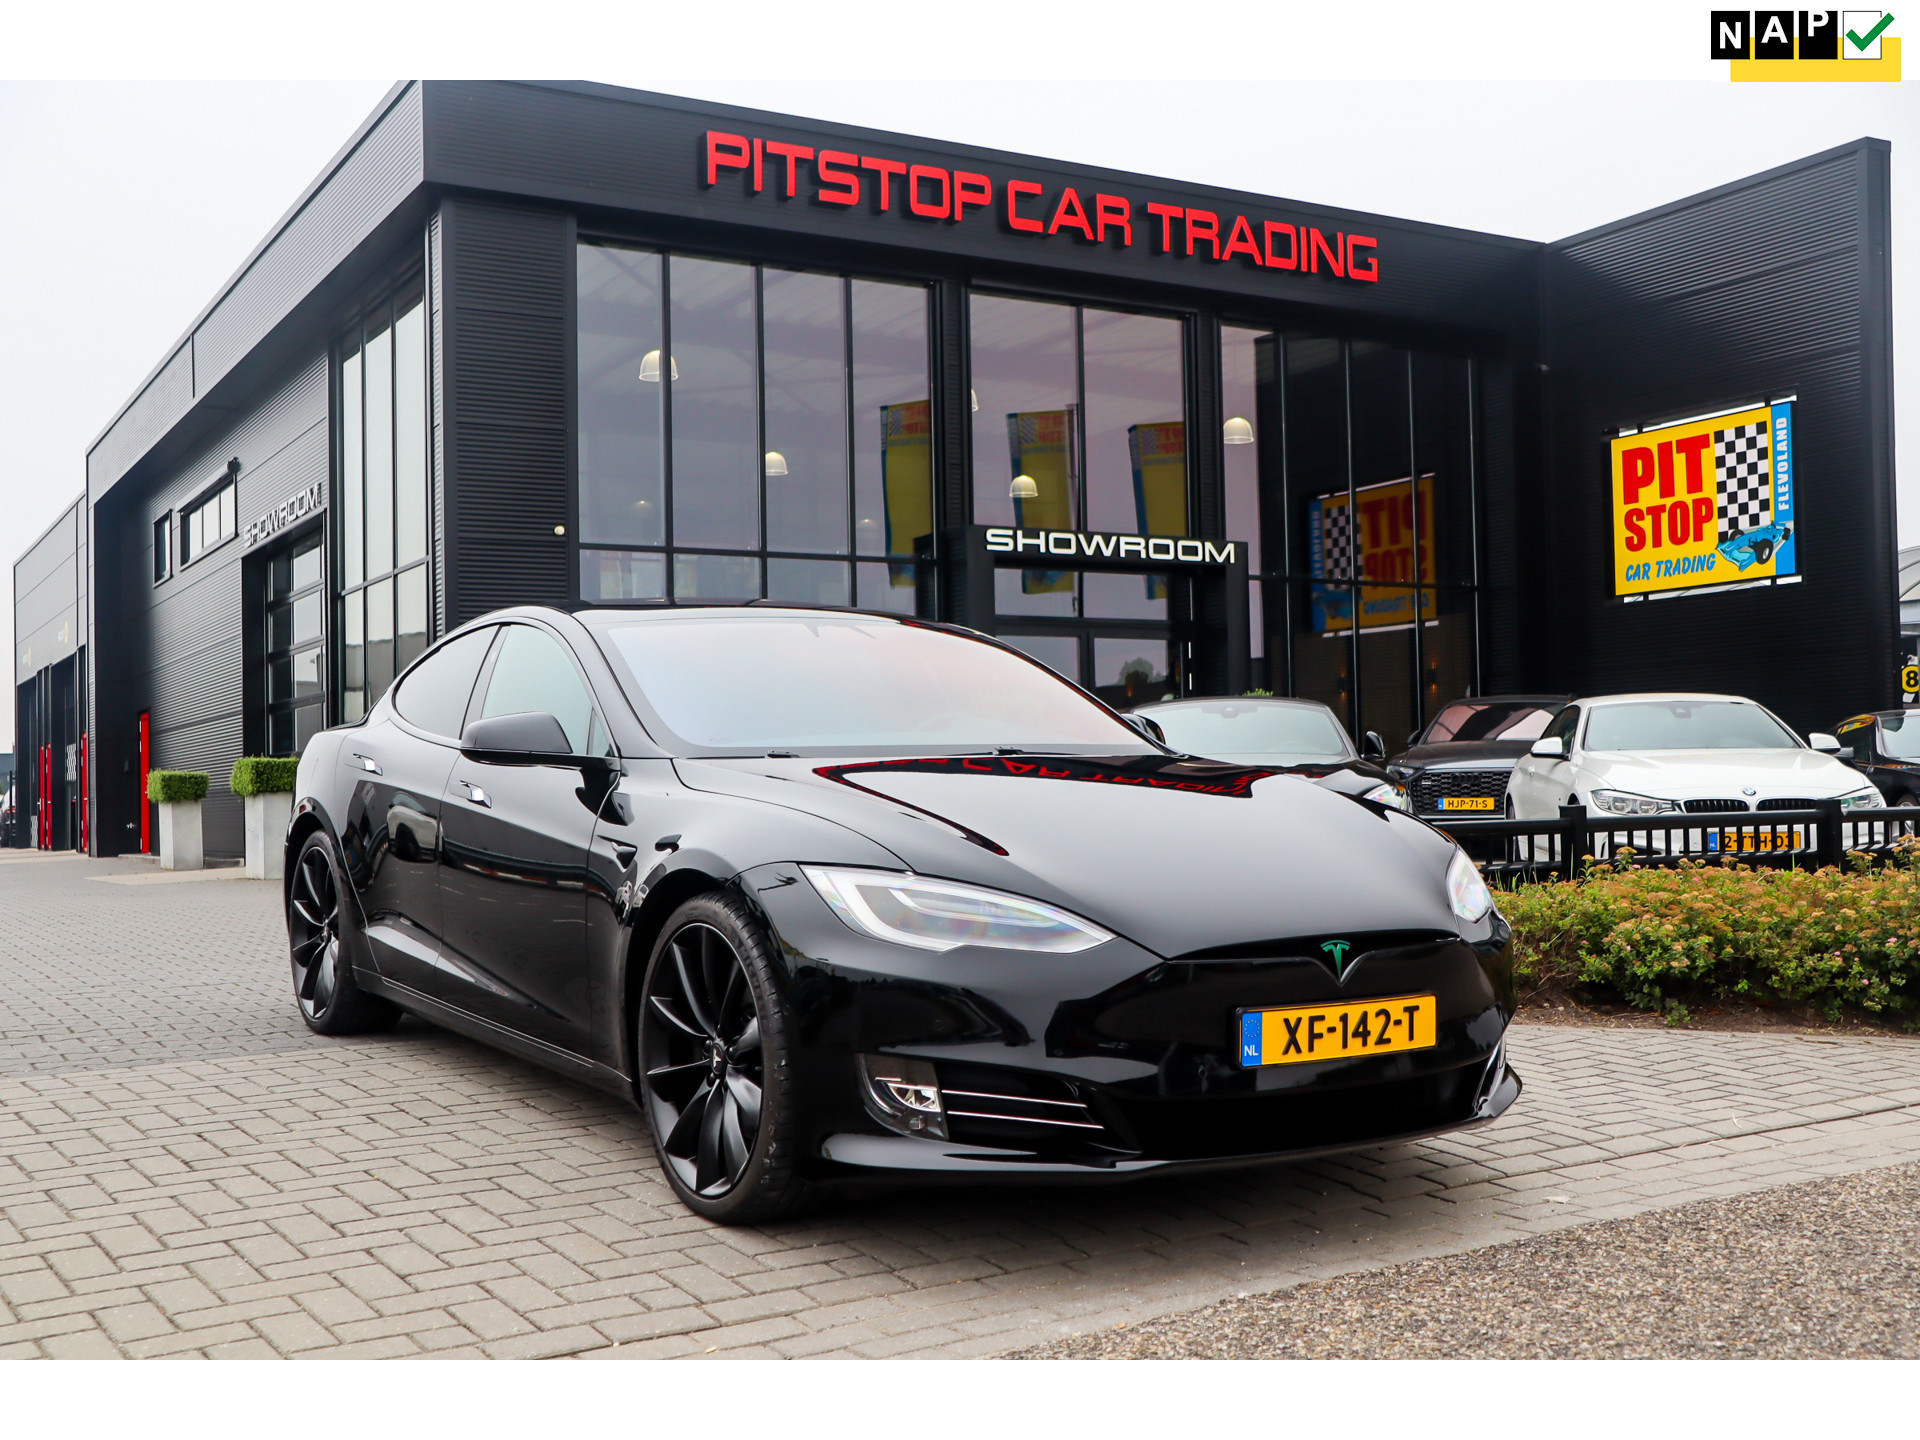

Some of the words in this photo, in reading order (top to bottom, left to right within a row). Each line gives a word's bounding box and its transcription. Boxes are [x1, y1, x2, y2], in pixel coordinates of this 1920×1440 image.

[705, 130, 992, 221] PITSTOP
[1007, 178, 1133, 247] CAR
[1147, 202, 1379, 283] TRADING
[1621, 433, 1710, 505] PIT
[1776, 416, 1790, 511] FLEVOLAND
[243, 482, 319, 549] SHOWROOM
[1624, 497, 1715, 552] STOP
[985, 528, 1235, 564] SHOWROOM
[1625, 562, 1652, 582] CAR
[1655, 552, 1717, 579] TRADING
[1447, 799, 1488, 808] HJP-71-S
[1244, 1045, 1259, 1056] NL
[1281, 1004, 1420, 1055] XF-142-T
